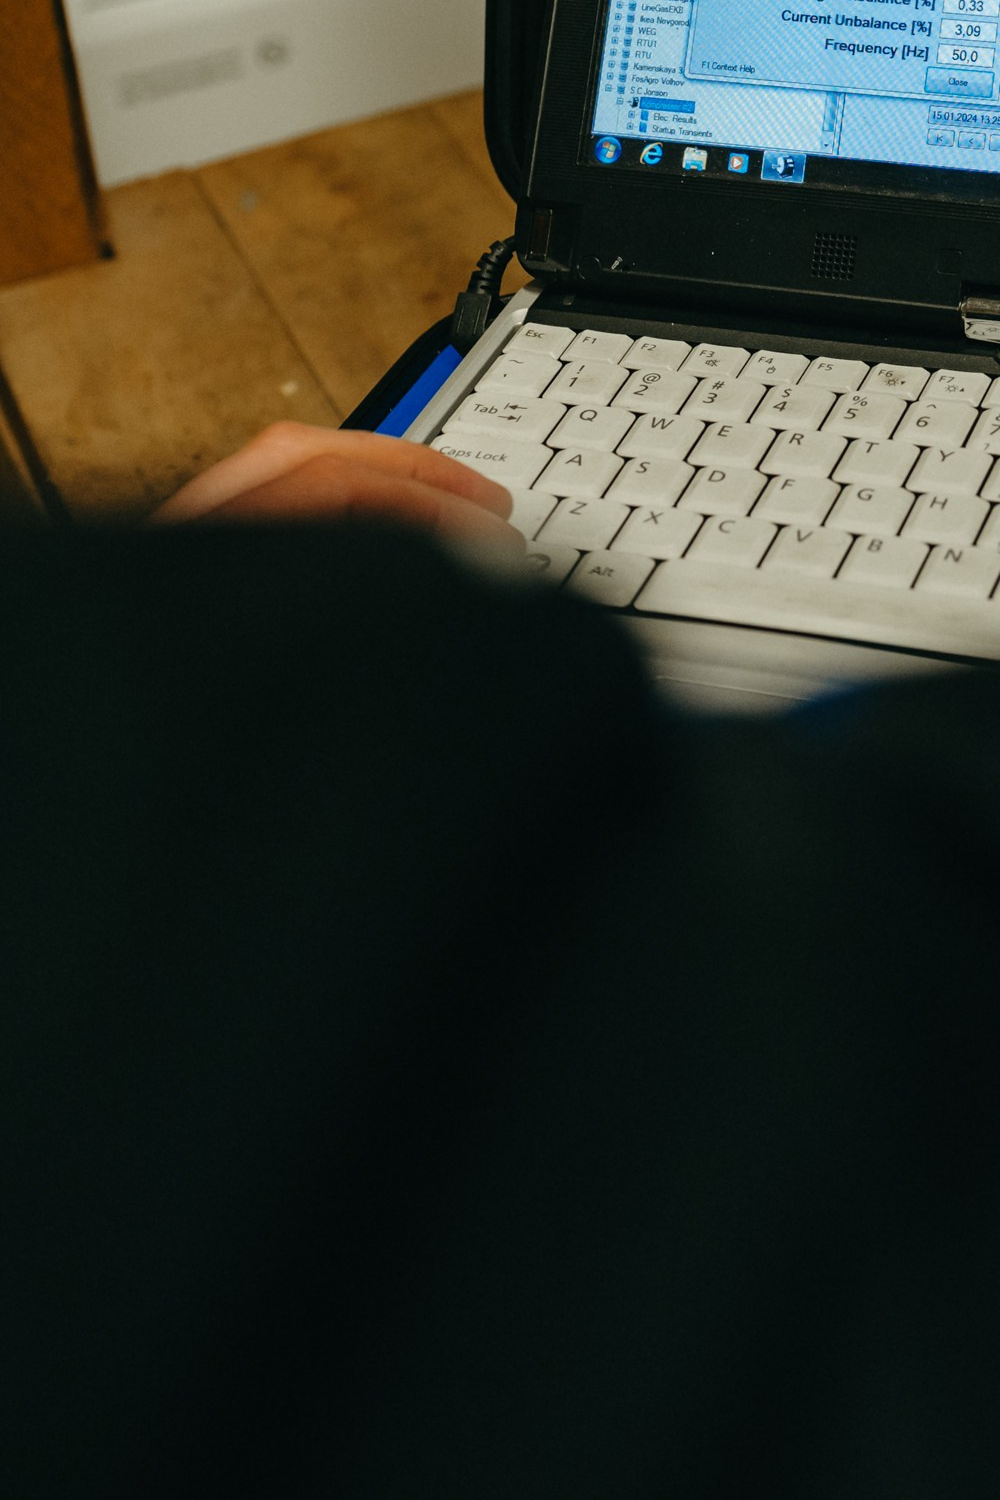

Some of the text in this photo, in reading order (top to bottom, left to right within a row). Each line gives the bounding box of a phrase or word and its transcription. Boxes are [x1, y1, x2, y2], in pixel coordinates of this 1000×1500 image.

[781, 10, 981, 38] Current Unbalance [%] 3,09
[638, 27, 656, 36] WEG
[825, 38, 978, 64] Frequency [Hz] 50,0
[712, 61, 738, 72] Context
[739, 63, 756, 74] Help
[948, 77, 968, 87] Close
[652, 125, 713, 137] Startup Transients
[525, 329, 545, 339] Esc
[582, 337, 597, 345] F1
[641, 343, 656, 351] F2
[699, 349, 715, 358] F3
[757, 356, 774, 365] F4
[817, 363, 834, 371] F5
[878, 369, 894, 378] F6
[939, 375, 955, 383] F7
[567, 377, 579, 388] 1
[633, 385, 649, 396] 2
[702, 392, 718, 404] 3
[473, 403, 498, 415] Tab
[773, 401, 787, 412] 4
[579, 409, 598, 422] Q
[844, 408, 859, 419] 5
[650, 417, 675, 430] W
[916, 416, 930, 427] 6
[717, 425, 733, 437] E
[788, 433, 804, 445] R
[865, 441, 879, 453] T
[939, 450, 955, 462] Y
